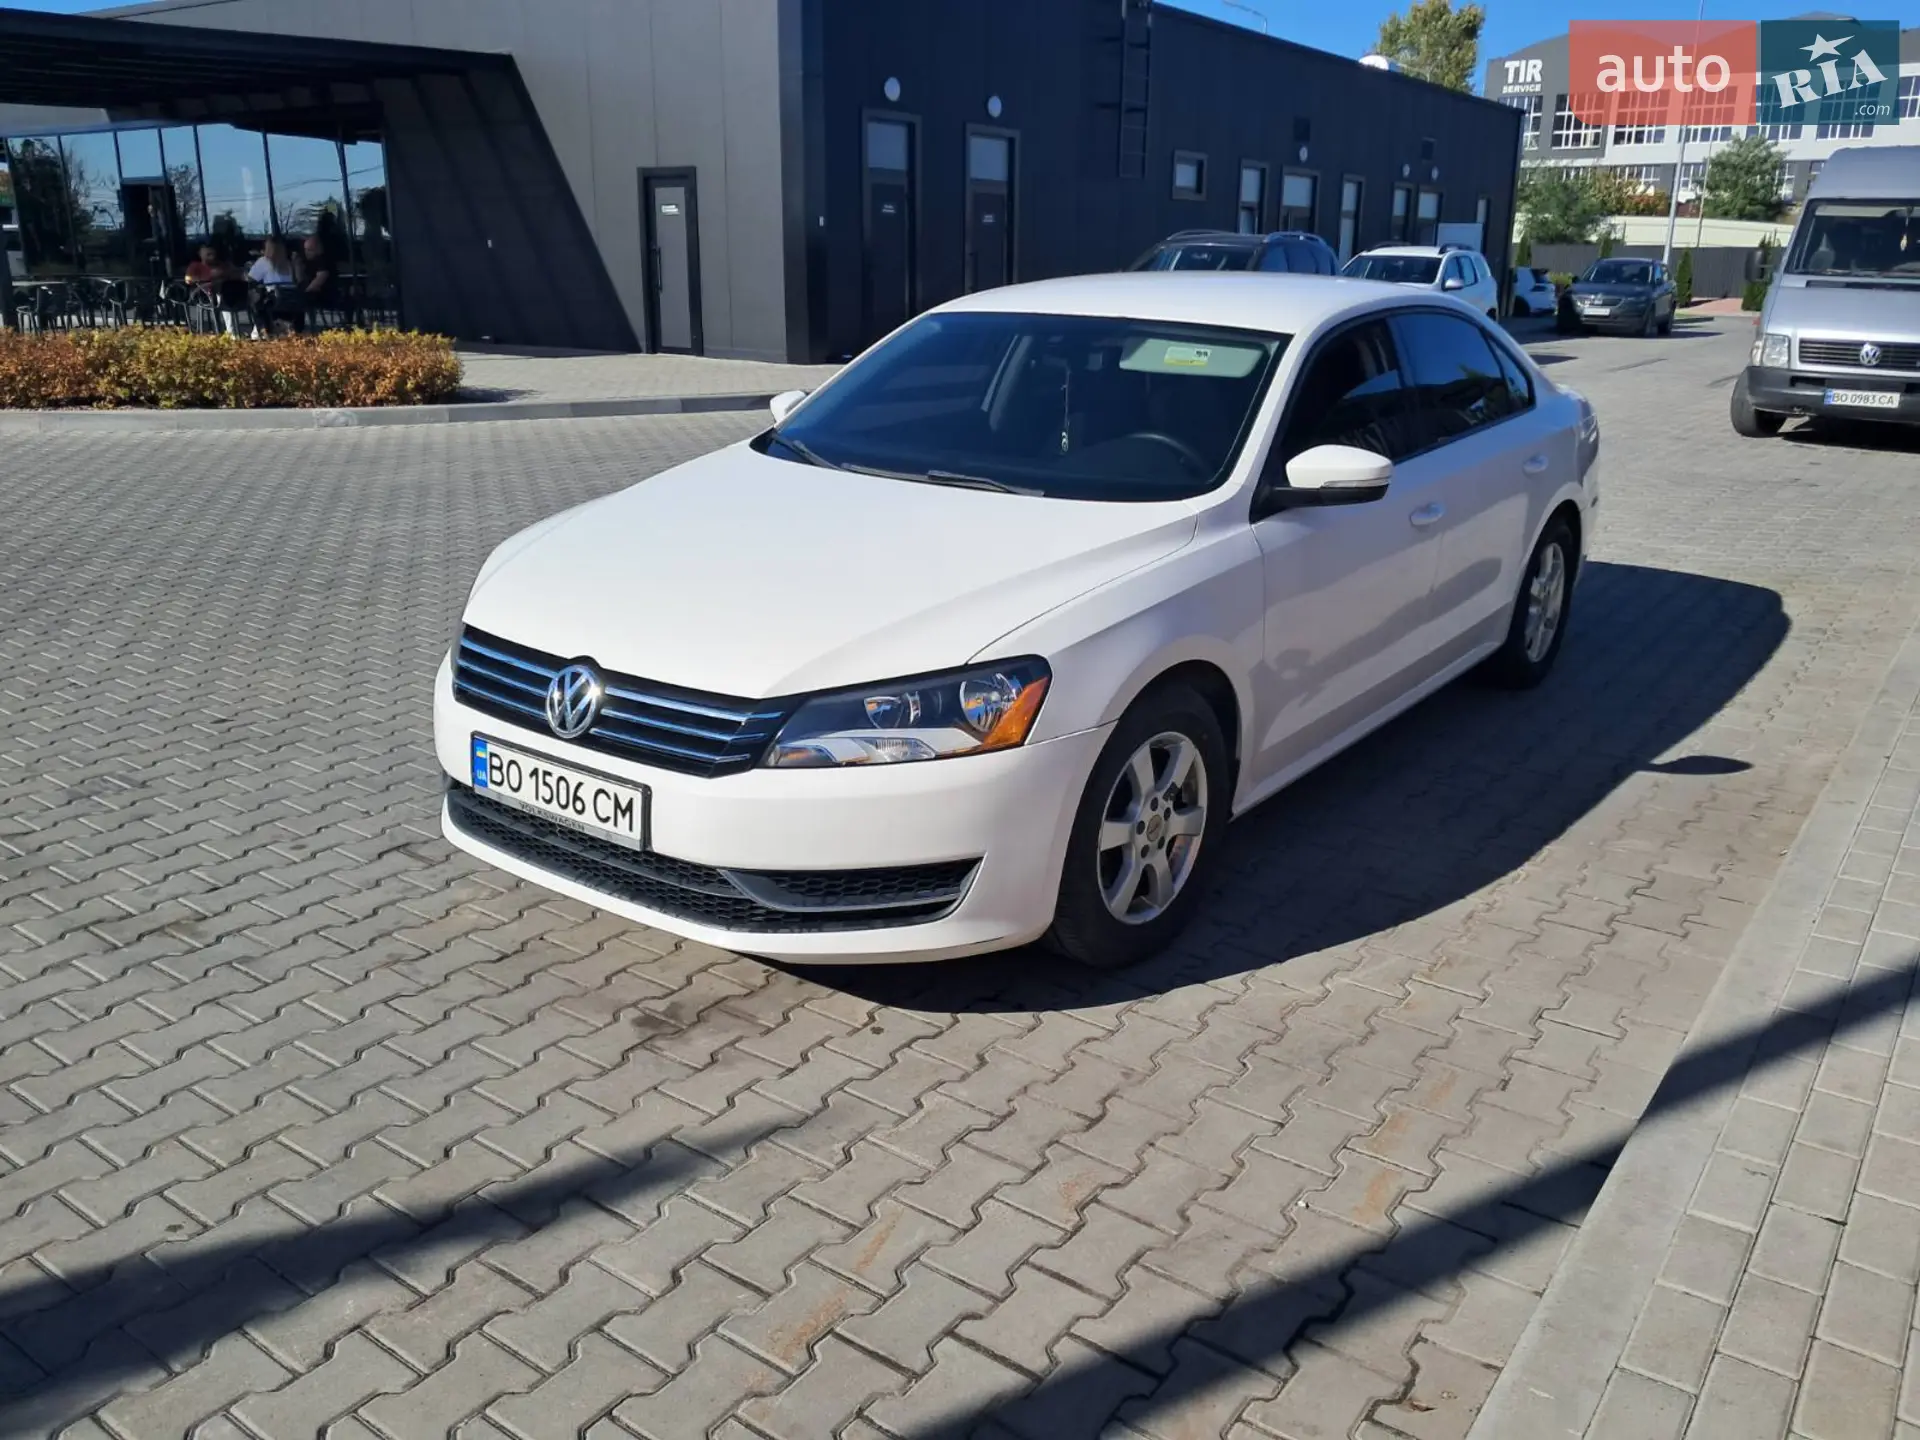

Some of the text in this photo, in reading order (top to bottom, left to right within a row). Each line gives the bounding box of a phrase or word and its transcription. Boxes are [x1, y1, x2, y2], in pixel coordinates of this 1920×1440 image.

[1504, 59, 1543, 84] TIR
[1502, 83, 1542, 94] SERVICE
[1832, 392, 1895, 405] BO 0983 CA
[476, 770, 487, 781] UA
[489, 752, 634, 833] BO 1506 CM
